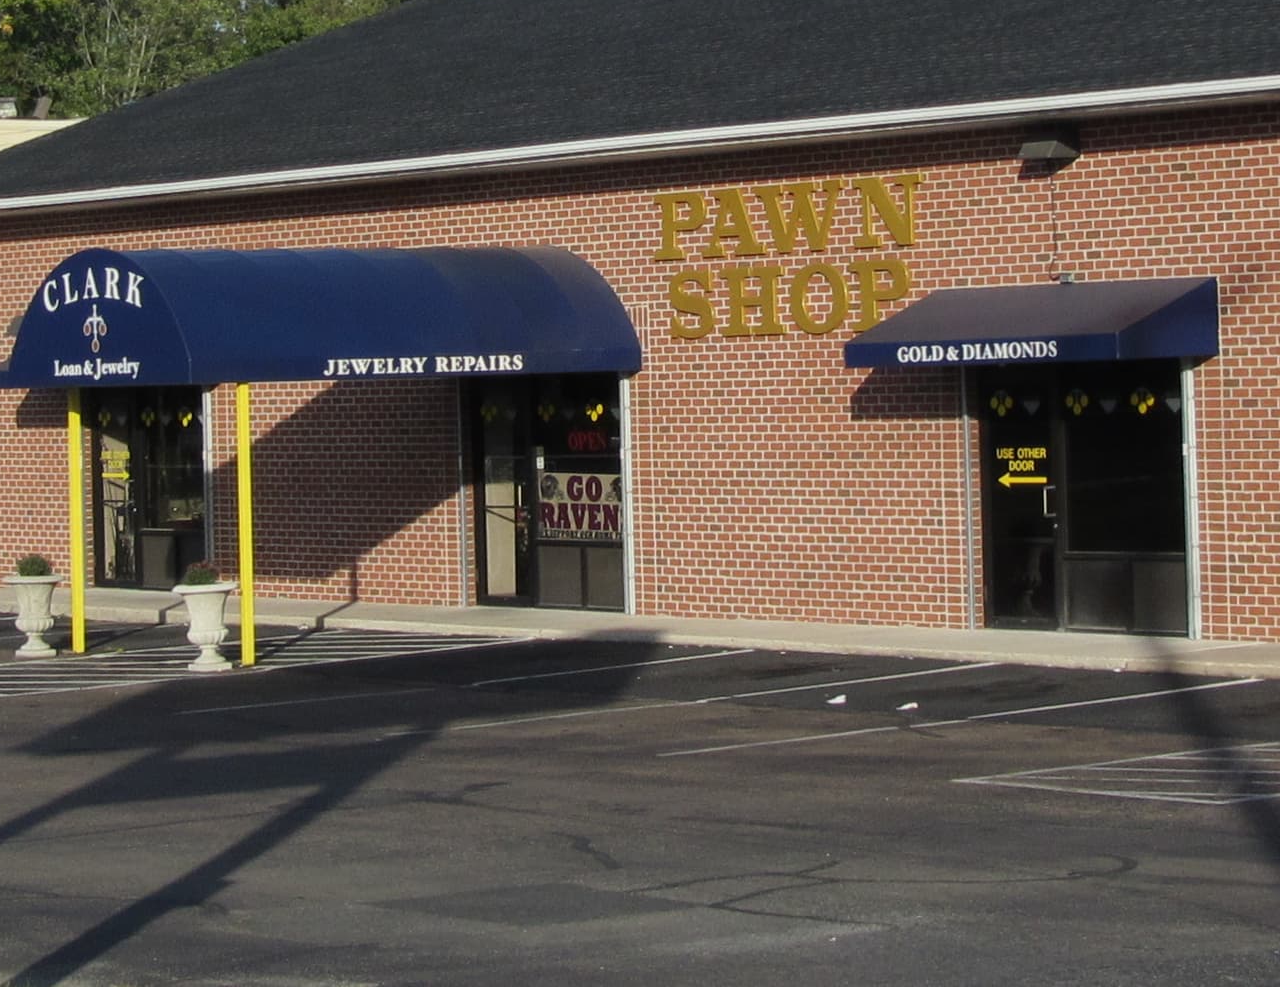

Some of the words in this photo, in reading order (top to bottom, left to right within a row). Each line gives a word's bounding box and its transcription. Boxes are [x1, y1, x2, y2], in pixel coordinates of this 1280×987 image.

[653, 173, 925, 262] PAWN
[43, 267, 145, 313] CLARK
[670, 259, 912, 340] SHOP
[897, 345, 944, 363] GOLD
[946, 346, 959, 361] &
[962, 340, 1058, 361] DIAMONDS
[53, 359, 83, 377] Loan
[83, 359, 94, 376] &
[93, 356, 140, 381] Jewelry
[323, 358, 428, 376] JEWELRY
[435, 354, 524, 373] REPAIRS
[568, 431, 607, 452] OPEN
[996, 447, 1015, 459] USE
[1017, 447, 1047, 459] OTHER
[1009, 460, 1035, 471] DOOR
[566, 475, 603, 502] GO
[540, 502, 623, 532] RAVEN
